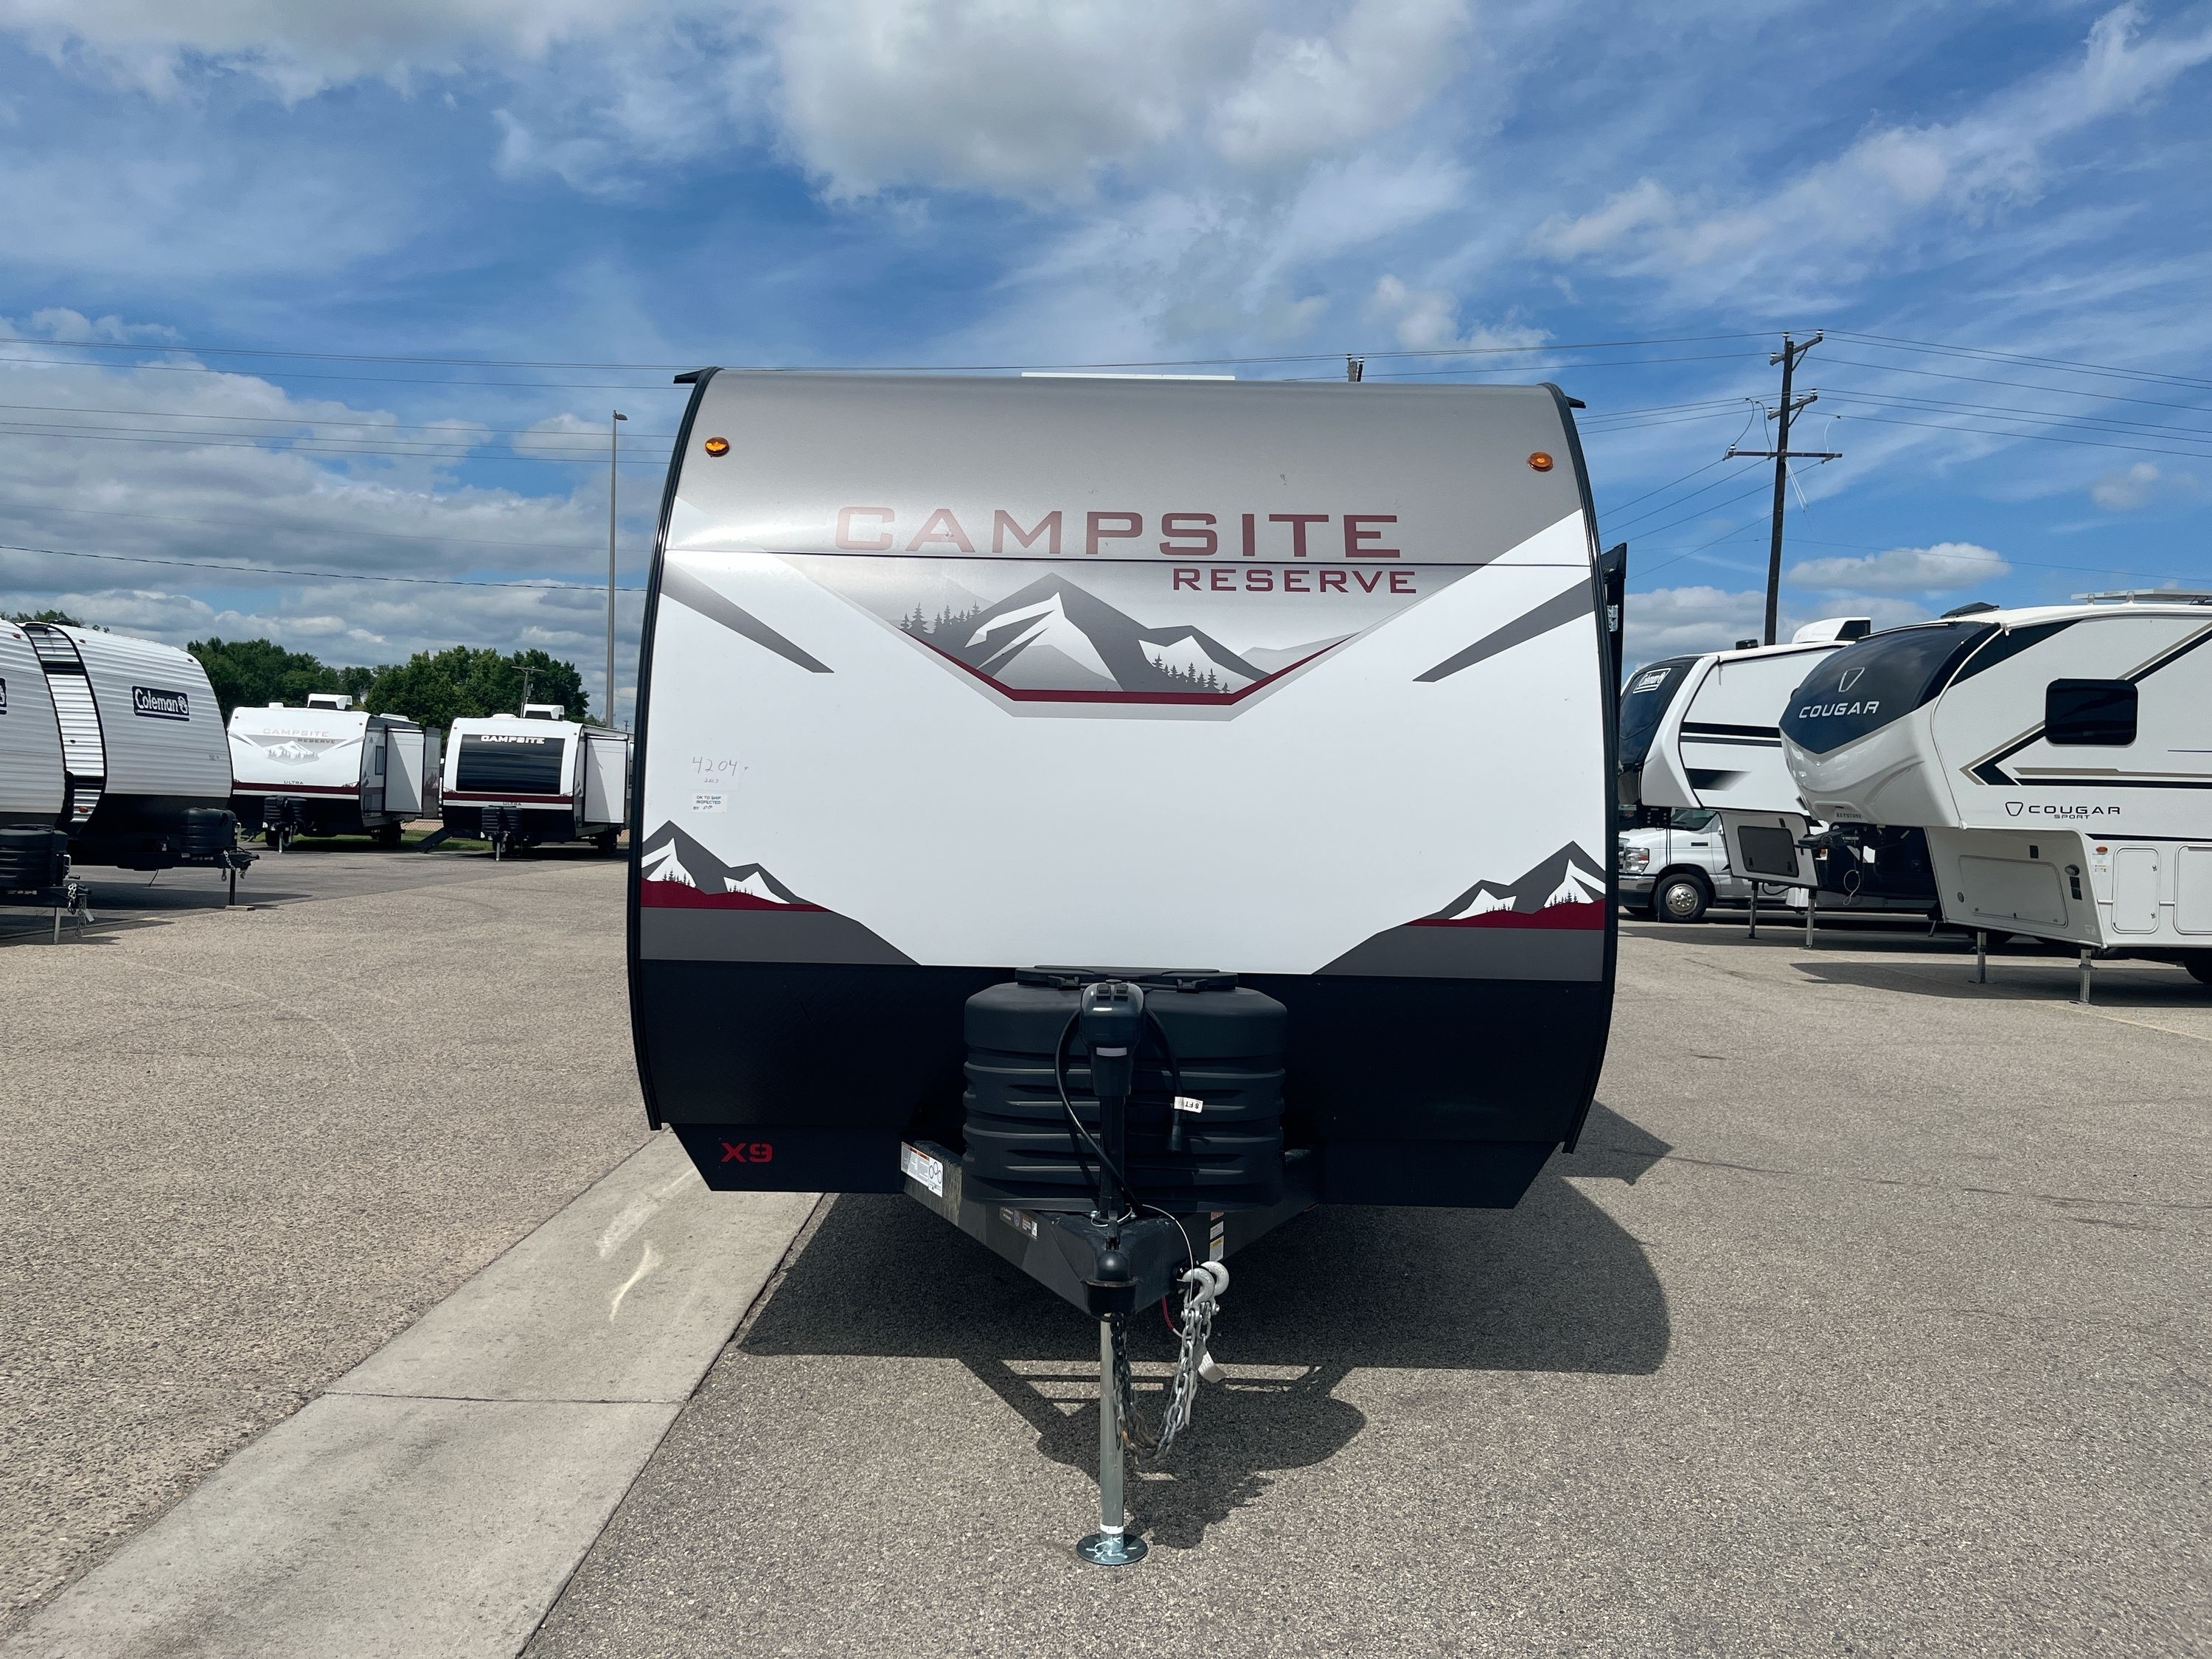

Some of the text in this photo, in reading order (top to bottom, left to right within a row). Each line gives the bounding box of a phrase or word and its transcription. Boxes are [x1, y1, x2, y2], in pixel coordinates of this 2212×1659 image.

[836, 507, 1401, 558] CAMPSITE
[1173, 568, 1417, 594] RESERVE
[134, 688, 179, 712] Coleman
[1799, 701, 1879, 718] COUGAR
[262, 728, 330, 737] CAMPSITE
[481, 735, 545, 745] CAMPSITE
[2028, 805, 2121, 815] COUGAR
[721, 1143, 773, 1163] X9
